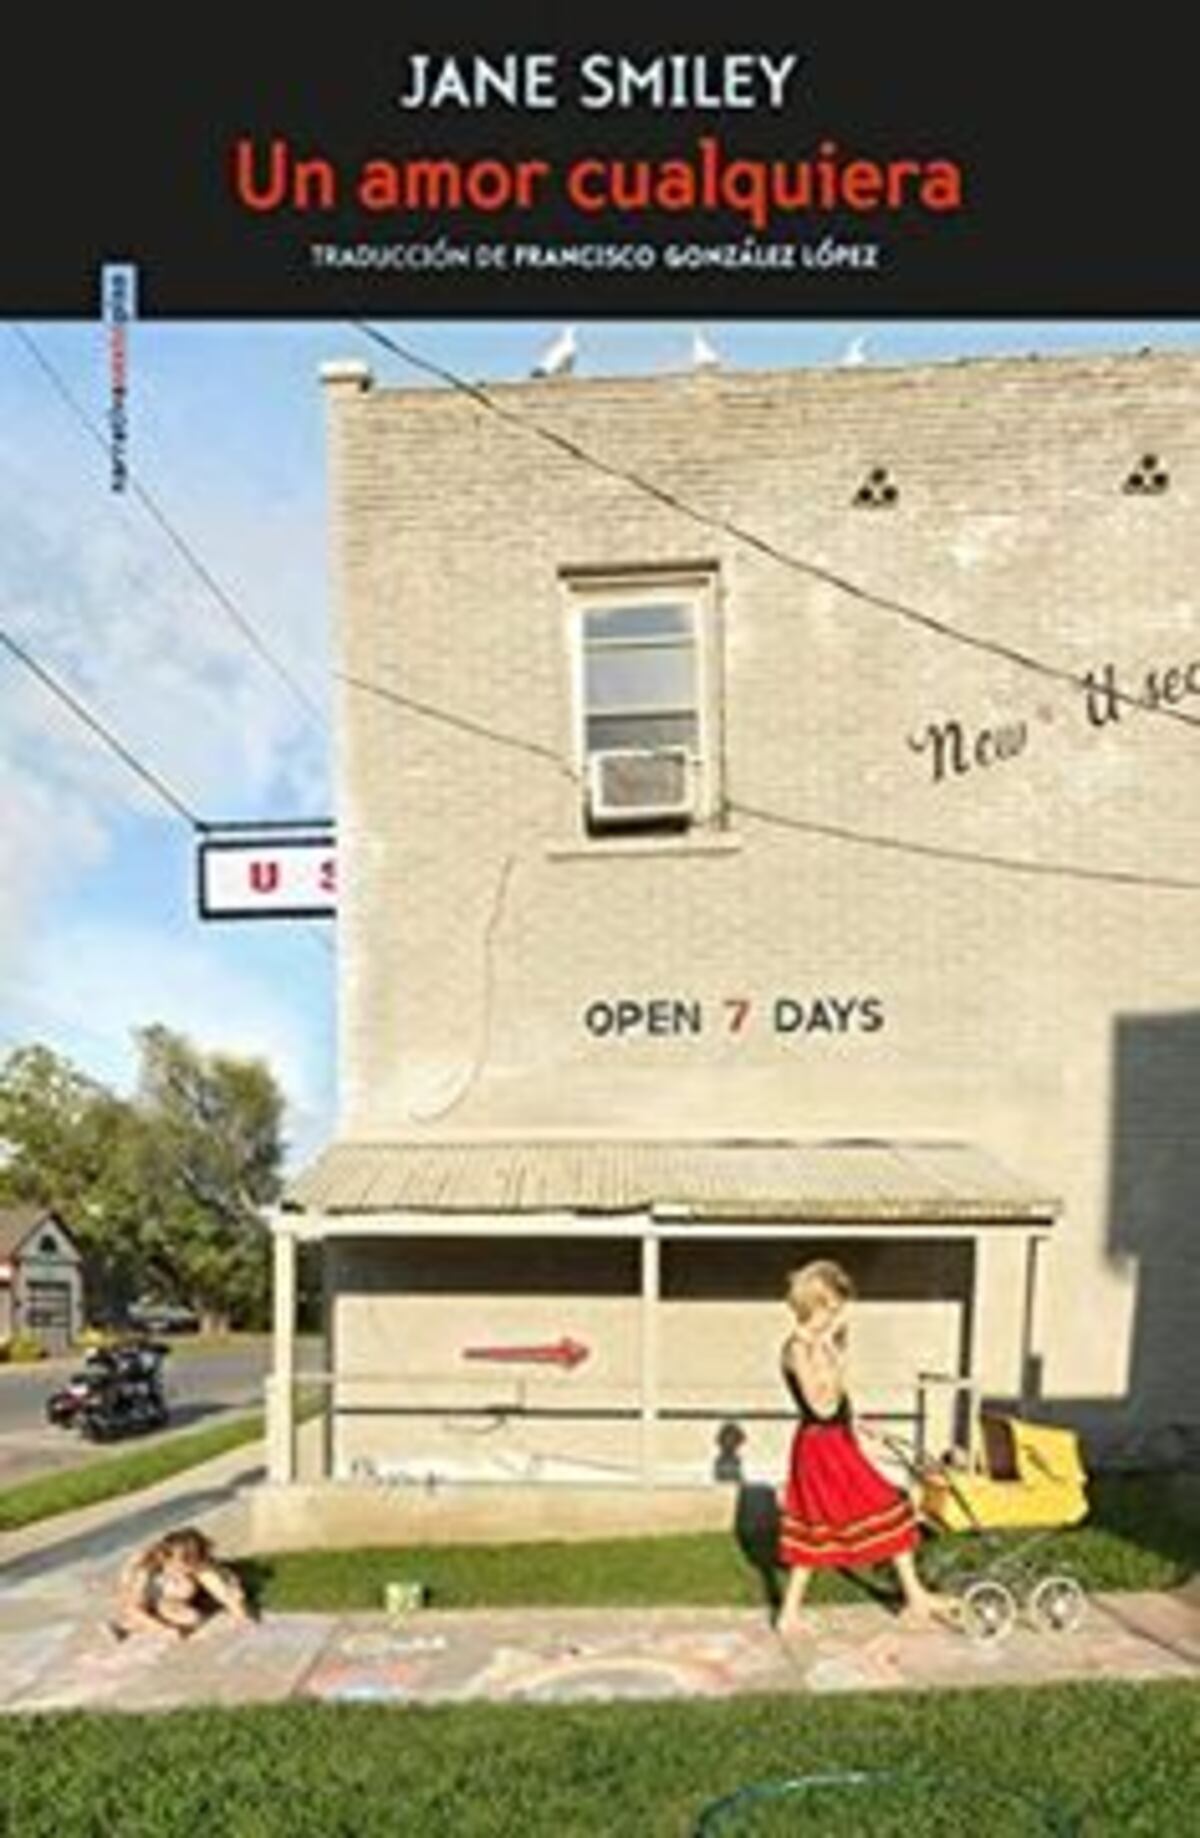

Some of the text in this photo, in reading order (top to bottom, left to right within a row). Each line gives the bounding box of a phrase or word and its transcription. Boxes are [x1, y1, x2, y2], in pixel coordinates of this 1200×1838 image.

[585, 998, 885, 1037] OPEN 7 DAYS
